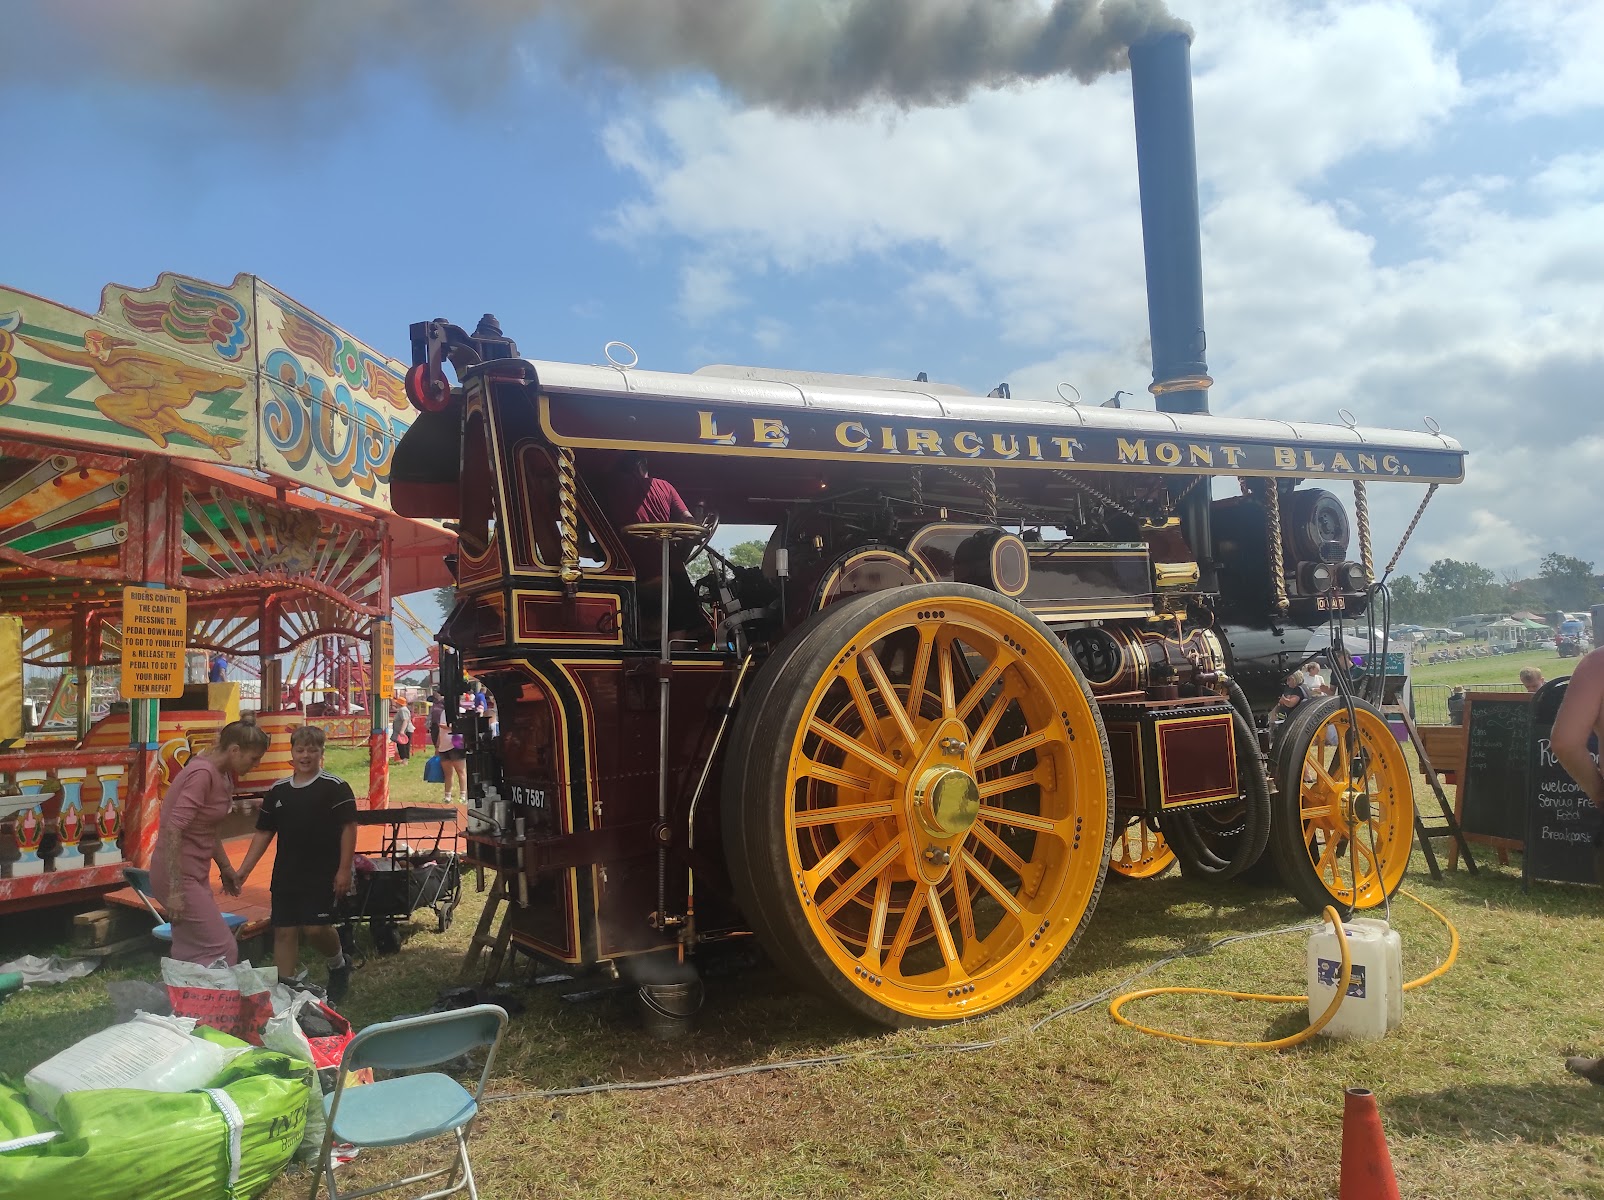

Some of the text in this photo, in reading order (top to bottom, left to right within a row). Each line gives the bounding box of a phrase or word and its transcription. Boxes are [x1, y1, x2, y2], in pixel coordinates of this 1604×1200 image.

[263, 347, 411, 480] SUP
[697, 411, 790, 448] LE
[834, 421, 1084, 461] CIRCUIT
[1116, 437, 1246, 469] MONT
[130, 591, 181, 604] RIDERS CONTROL
[138, 604, 174, 615] THE CAR BY
[134, 615, 177, 626] PRESSING THE
[126, 626, 184, 637] PEDAL DOWN HARD
[125, 637, 184, 649] TO GO TO YOUR LEFT
[131, 649, 176, 659] & RELEASE THE
[129, 661, 177, 670] PEDAL TO GO TO
[135, 672, 172, 681] YOUR RIGHT
[133, 684, 173, 693] THEN REPEAT
[511, 785, 545, 808] XG 7587
